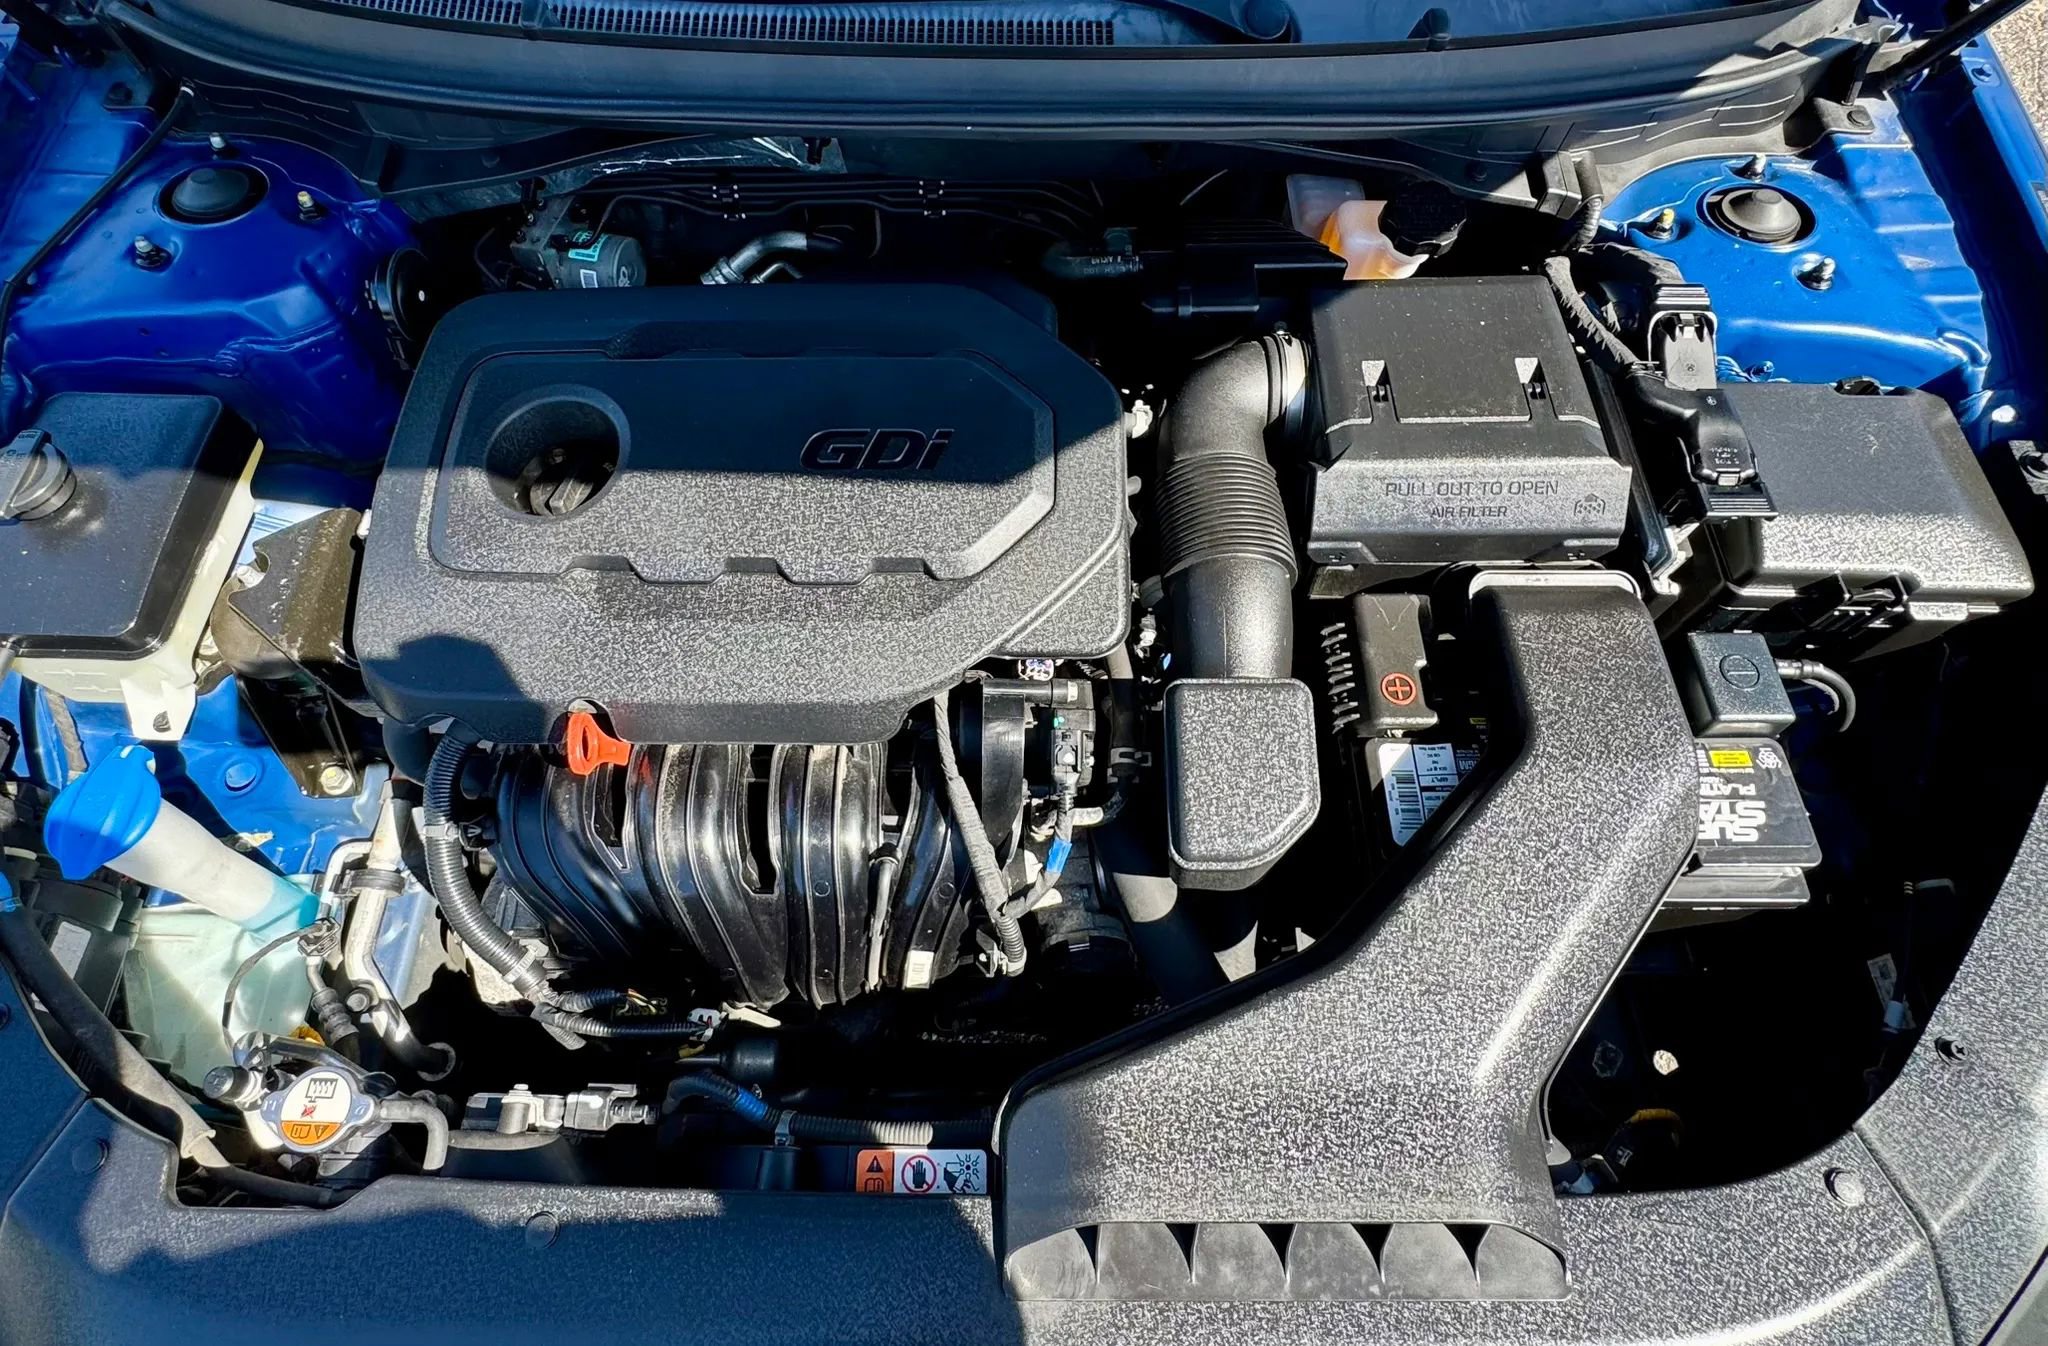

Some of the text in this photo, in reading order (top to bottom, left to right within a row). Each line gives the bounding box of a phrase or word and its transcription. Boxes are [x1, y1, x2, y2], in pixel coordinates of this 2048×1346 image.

[800, 429, 954, 469] GDi
[1385, 480, 1559, 497] PULL OUT TO OPEN
[1431, 506, 1508, 518] AIR FILTER
